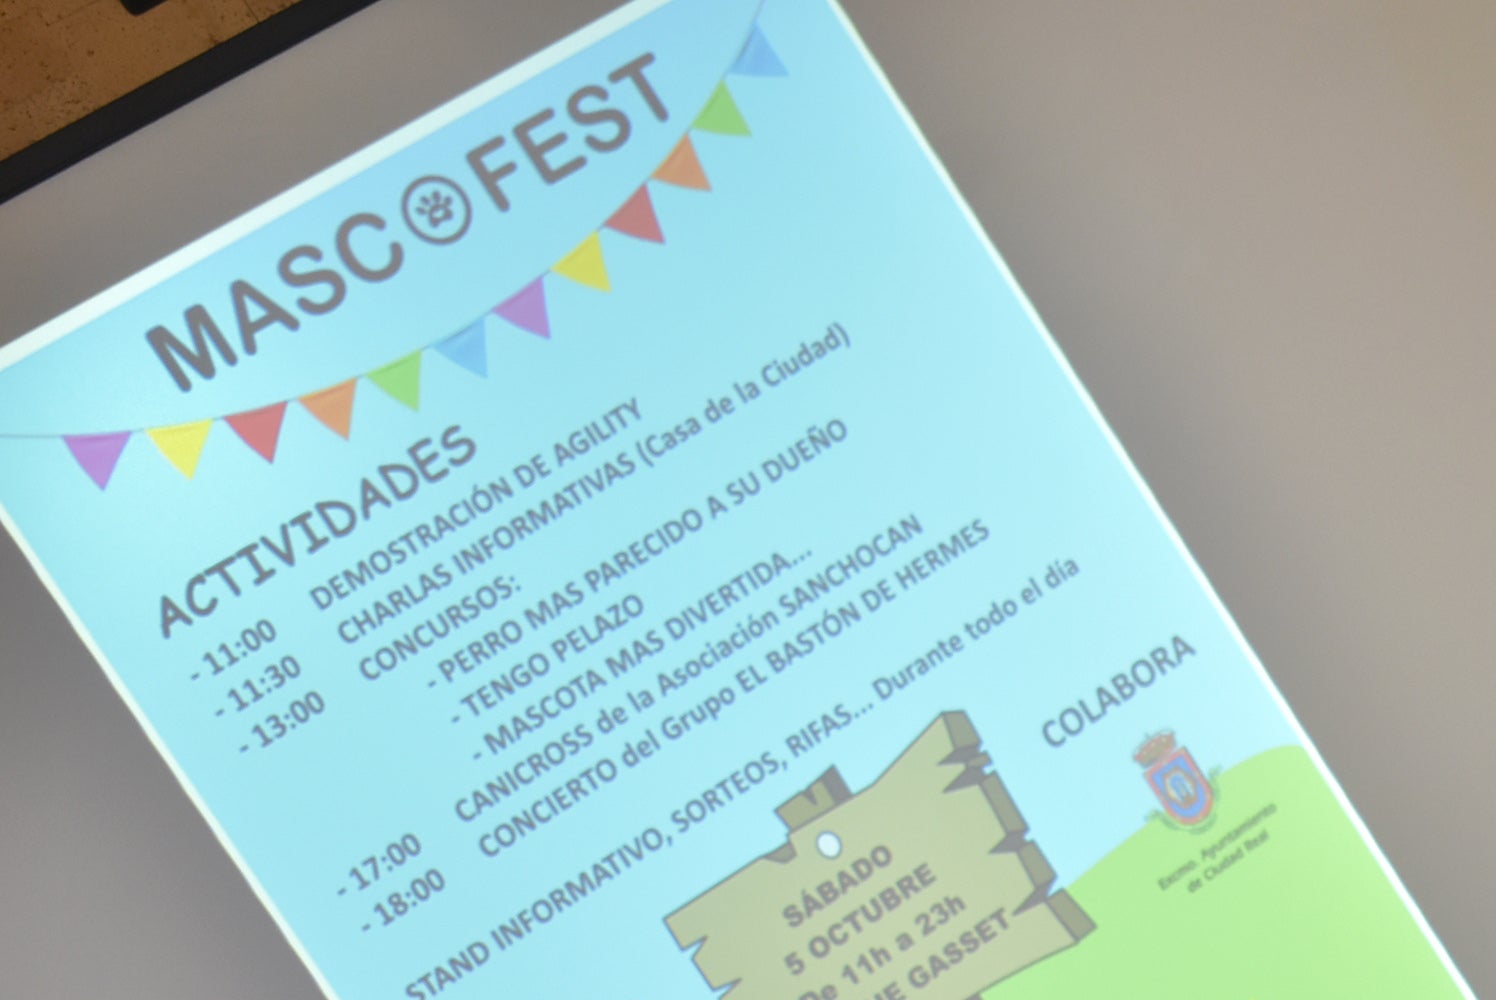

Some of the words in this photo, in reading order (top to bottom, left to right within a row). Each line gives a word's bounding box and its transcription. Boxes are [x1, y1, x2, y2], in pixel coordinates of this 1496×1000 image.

[159, 424, 477, 640] ACTIVIDADES
[201, 618, 277, 676] 11:00
[308, 475, 514, 611] DEMOSTRACIÓN
[511, 453, 552, 489] DE
[552, 396, 641, 467] AGILITY
[226, 654, 301, 712] 11:30
[336, 562, 453, 644] CHARLAS
[450, 451, 636, 575] INFORMATIVAS
[634, 416, 702, 468] (Casa
[703, 396, 735, 424] de
[732, 380, 761, 404] la
[760, 321, 850, 387] Ciudad)
[436, 619, 523, 683] PERRO
[522, 580, 584, 630] MAS
[582, 507, 703, 593] PARECIDO
[706, 495, 728, 520] A
[725, 470, 761, 505] SU
[760, 418, 847, 483] DUEÑO
[250, 690, 325, 748] 13:00
[358, 575, 521, 681] CONCURSOS:
[348, 832, 422, 891] 17:00
[453, 722, 594, 822] CANICROSS
[595, 705, 629, 735] de
[625, 689, 655, 713] la
[656, 609, 780, 697] Asociación
[777, 513, 923, 617] SANCHOCAN
[372, 867, 445, 926] 18:00
[477, 757, 618, 858] CONCIERTO
[620, 728, 661, 768] del
[660, 686, 735, 740] Grupo
[734, 664, 768, 693] EL
[764, 600, 862, 674] BASTÓN
[859, 578, 896, 613] DE
[893, 518, 990, 590] HERMES
[459, 651, 550, 716] TENGO
[549, 593, 644, 663] PELAZO
[482, 668, 608, 755] MASCOTA
[603, 628, 665, 679] MAS
[663, 549, 812, 641] DIVERTIDA...
[489, 826, 673, 951] INFORMATIVO,
[669, 750, 788, 833] SORTEOS,
[784, 702, 874, 758] RIFAS...
[870, 633, 964, 701] Durante
[963, 598, 1018, 640] todo
[1019, 576, 1043, 605] el
[1043, 558, 1080, 589] día
[1041, 634, 1196, 748] COLABORA
[781, 844, 892, 928] SÁBADO
[783, 951, 805, 975] 5
[807, 862, 936, 959] OCTUBRE
[841, 946, 892, 984] 11h
[894, 931, 915, 951] a
[913, 895, 966, 937] 23h
[907, 906, 1008, 989] GASSET
